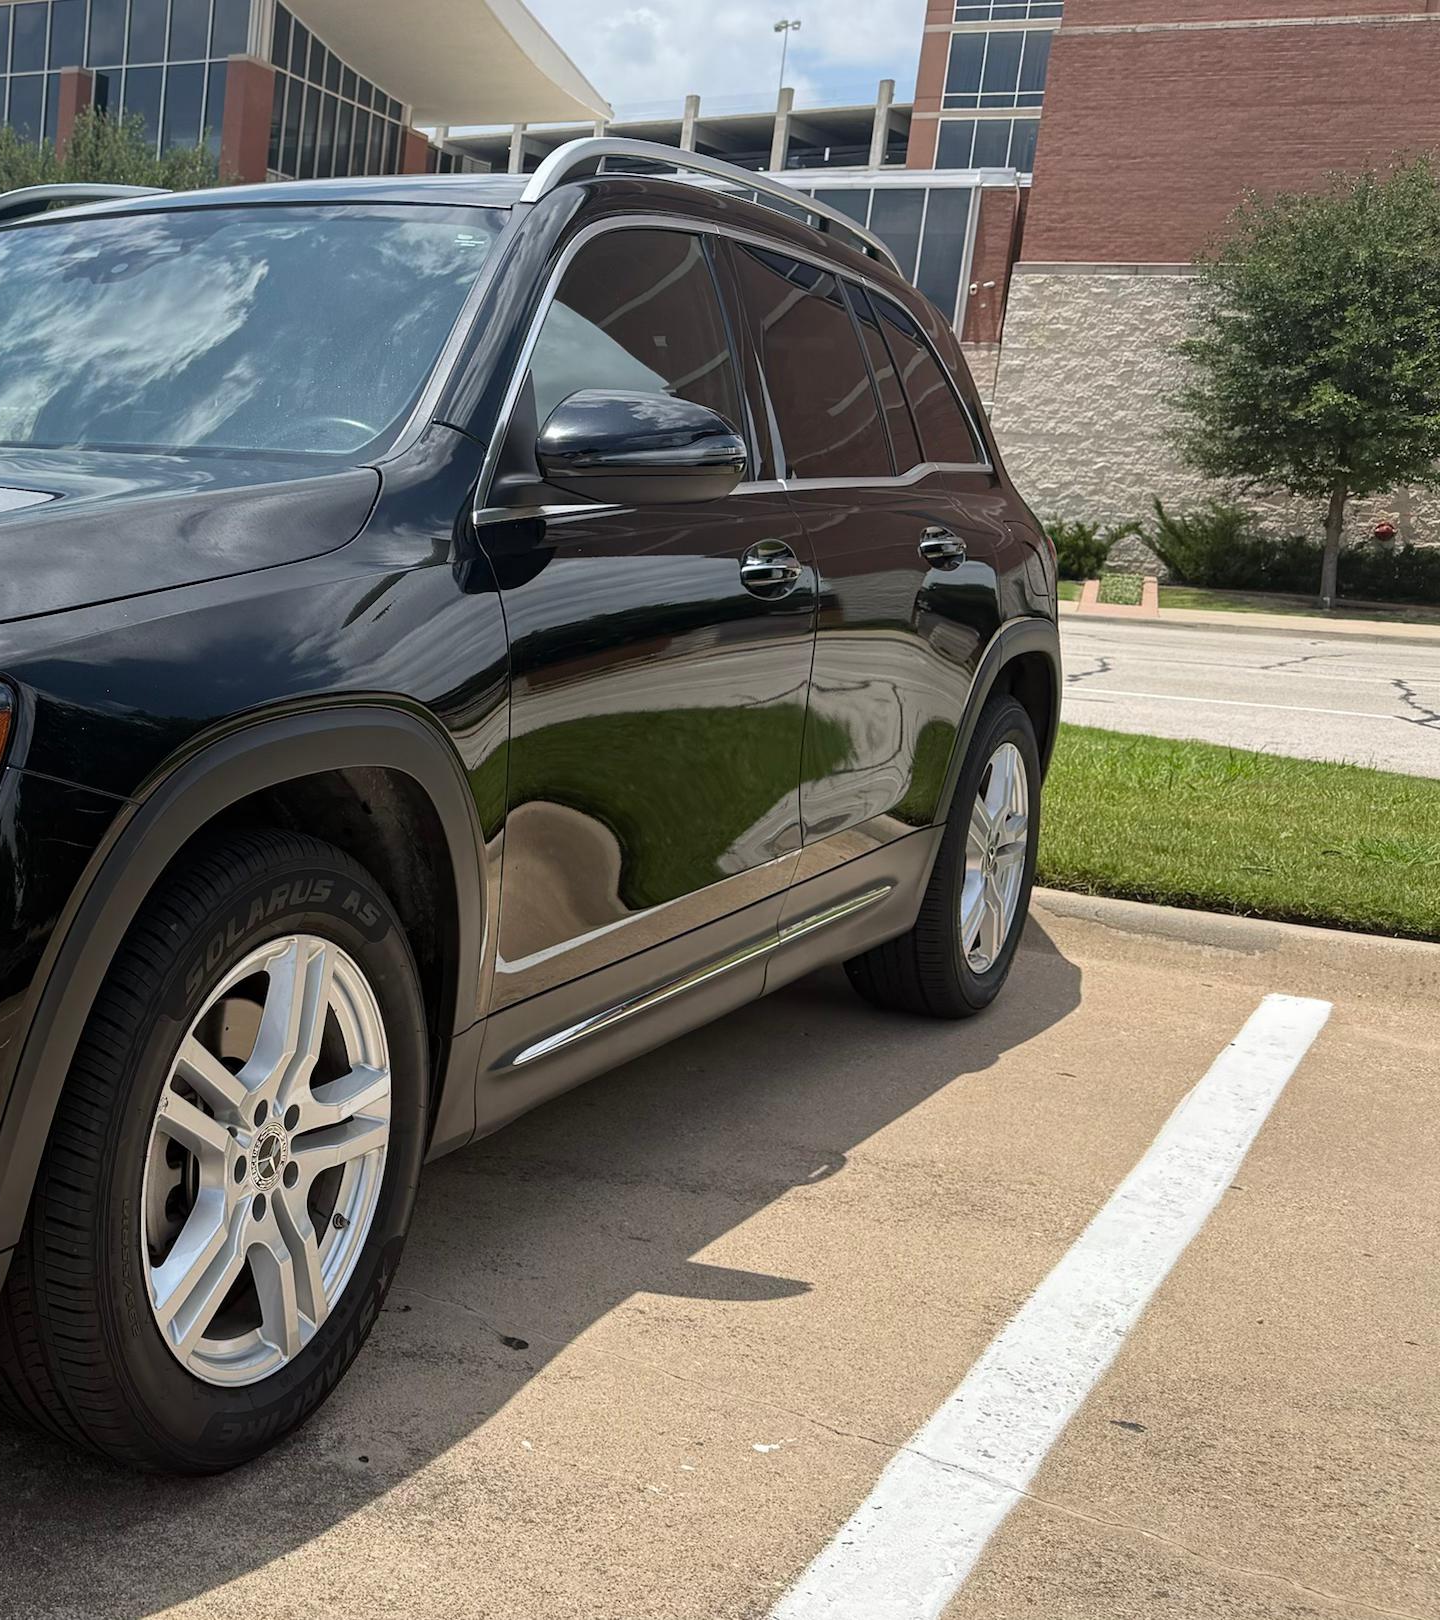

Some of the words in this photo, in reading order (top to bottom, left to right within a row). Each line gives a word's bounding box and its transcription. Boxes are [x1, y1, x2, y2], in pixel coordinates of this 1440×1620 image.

[184, 878, 336, 1005] SOLARUS
[341, 890, 382, 927] AS
[217, 1294, 375, 1445] STARFIRE
